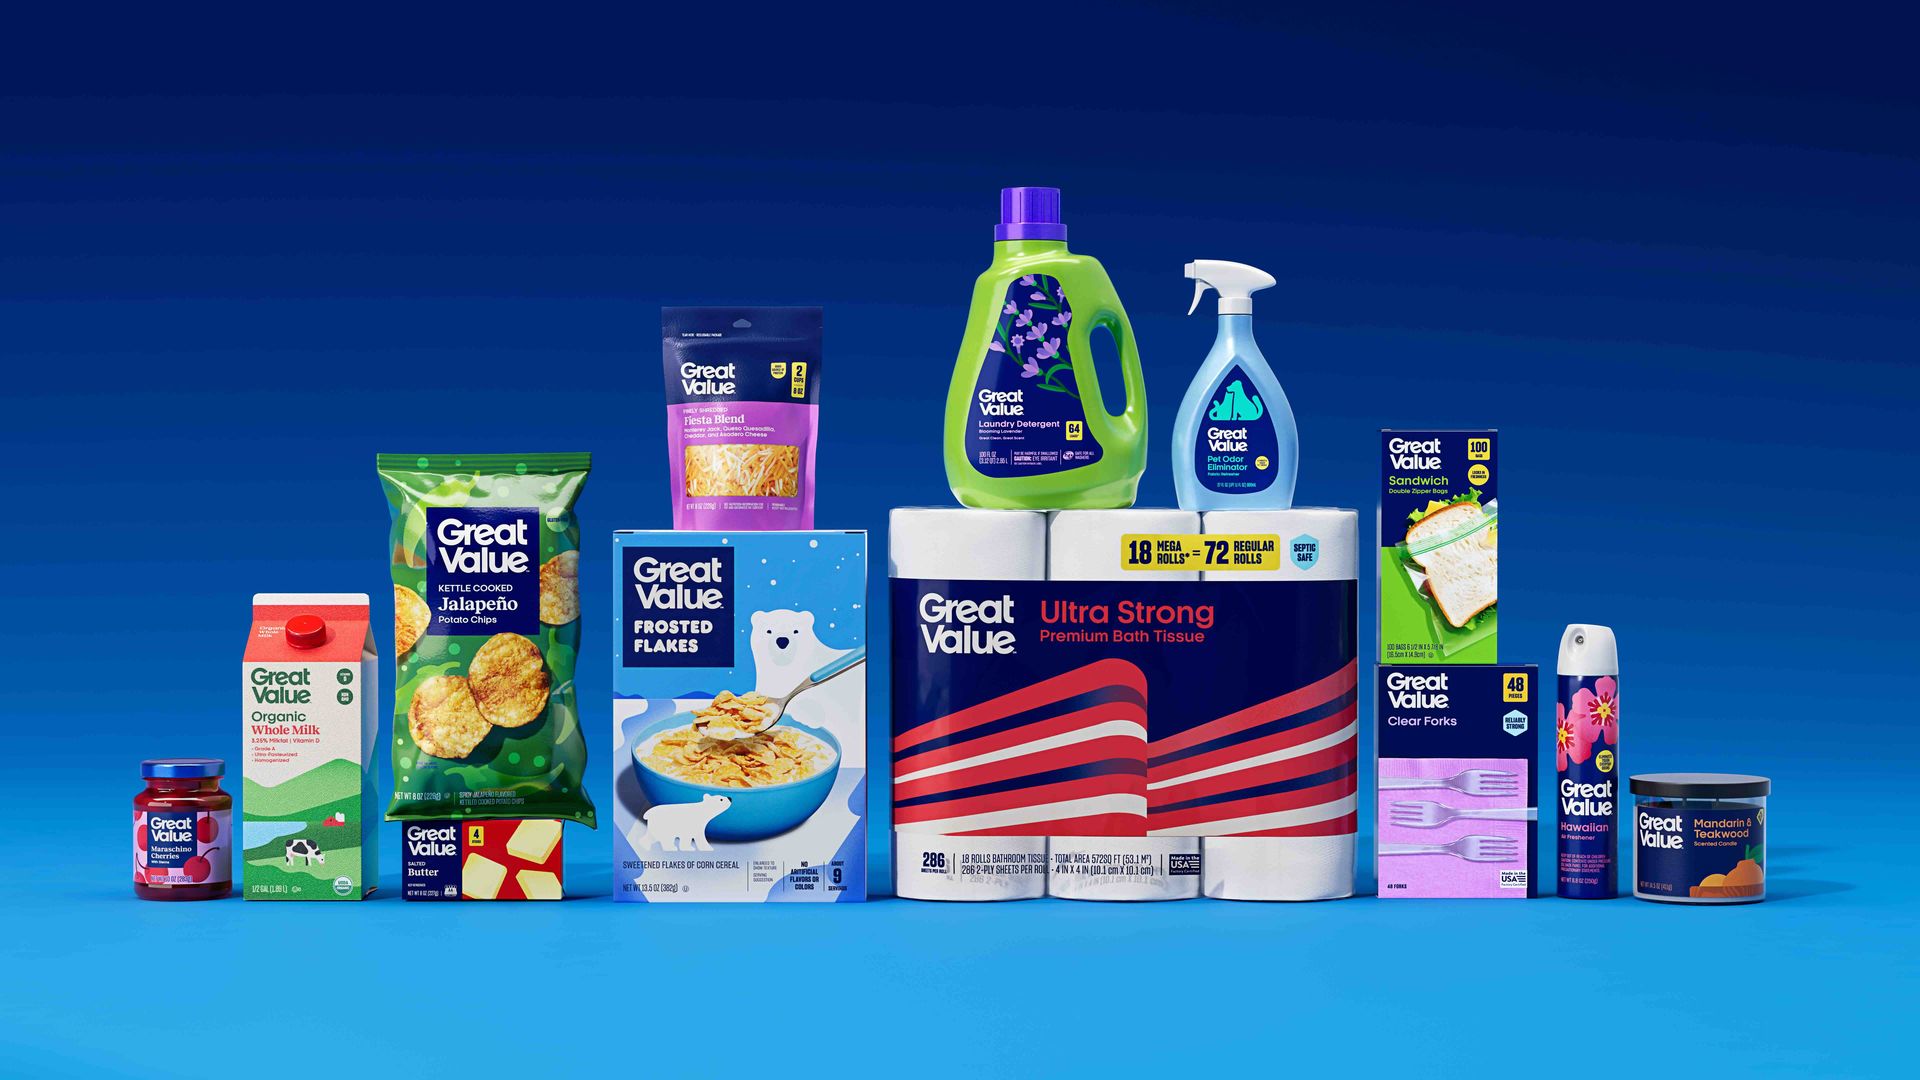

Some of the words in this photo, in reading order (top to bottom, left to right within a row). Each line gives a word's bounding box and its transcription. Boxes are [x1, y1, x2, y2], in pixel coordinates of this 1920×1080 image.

[681, 362, 735, 379] Great
[796, 365, 802, 376] 2
[682, 379, 736, 395] Value
[978, 389, 1023, 403] Great
[980, 403, 1024, 416] Value
[684, 416, 712, 425] Fiesta
[715, 414, 744, 424] Blend
[1069, 424, 1080, 433] 64
[1208, 427, 1247, 440] Great
[1208, 440, 1248, 452] Value
[1389, 438, 1441, 454] Great
[1470, 441, 1487, 452] 100
[1390, 454, 1442, 470] Value
[1389, 476, 1448, 485] Sandwich
[437, 518, 528, 546] Great
[1128, 540, 1152, 564] 18
[1157, 541, 1181, 551] MEGA
[1204, 540, 1229, 564] 72
[1234, 540, 1274, 552] REGULAR
[1293, 544, 1316, 552] SEPTIC
[438, 547, 530, 573] Value
[1234, 553, 1262, 564] ROLLS
[1297, 554, 1313, 562] SAFE
[634, 556, 722, 583] Great
[438, 584, 471, 592] KETTLE
[473, 584, 513, 592] COOKED
[635, 584, 723, 609] Value
[437, 596, 518, 614] Jalapeño
[919, 592, 1015, 625] Great
[438, 616, 469, 624] Potato
[470, 616, 497, 625] Chips
[1041, 600, 1108, 624] Ultra
[1117, 599, 1214, 629] Strong
[634, 620, 713, 634] FROSTED
[921, 625, 1017, 655] Value
[1040, 629, 1108, 643] Premium
[1113, 629, 1149, 643] Bath
[1153, 629, 1204, 643] Tissue
[634, 638, 698, 653] FLAKES
[251, 667, 311, 686] Great
[1387, 672, 1448, 690] Great
[1507, 677, 1524, 691] 48
[252, 687, 311, 704] Value
[1388, 691, 1449, 708] Value
[252, 711, 306, 724] Organic
[1388, 716, 1421, 726] Clear
[1424, 716, 1457, 726] Forks
[252, 725, 290, 735] Whole
[292, 724, 320, 735] Milk
[1561, 779, 1612, 798] Great
[394, 792, 404, 800] NET
[1562, 798, 1613, 816] Value
[151, 817, 192, 829] Great
[1561, 822, 1608, 832] Hawaiian
[1639, 812, 1682, 832] Great
[1694, 819, 1744, 828] Mandarin
[152, 830, 192, 842] Value
[407, 826, 456, 841] Great
[473, 829, 479, 839] 4
[1640, 830, 1684, 849] Value
[1694, 829, 1749, 839] Teakwood
[408, 841, 457, 856] Value
[623, 861, 660, 869] SWEETENED
[662, 861, 685, 869] FLAKES
[687, 861, 695, 869] OF
[696, 861, 714, 869] CORN
[716, 861, 739, 869] CEREAL
[923, 852, 945, 868] 286
[962, 854, 969, 863] 18
[972, 854, 990, 863] ROLLS
[993, 854, 1026, 863] BATHROOM
[1028, 854, 1048, 863] TISSUE
[1055, 854, 1072, 863] TOTAL
[1074, 854, 1090, 863] AREA
[1092, 854, 1111, 864] 572SQ
[1114, 854, 1120, 864] FT
[1123, 854, 1139, 865] (53.1
[833, 868, 842, 884] 9
[962, 865, 975, 874] 286
[977, 865, 994, 874] 2-PLY
[996, 865, 1019, 874] SHEETS
[1021, 865, 1032, 874] PER
[1056, 865, 1059, 874] 4
[1062, 865, 1068, 874] IN
[1070, 865, 1074, 874] X
[1076, 865, 1080, 874] 4
[1082, 865, 1088, 874] IN
[1090, 865, 1106, 876] (10.1
[1120, 866, 1124, 874] X
[1126, 866, 1139, 875] 10.1
[1141, 866, 1154, 876] cm)
[270, 884, 281, 893] (1.89
[282, 885, 288, 893] L)
[661, 883, 678, 893] (382g)
